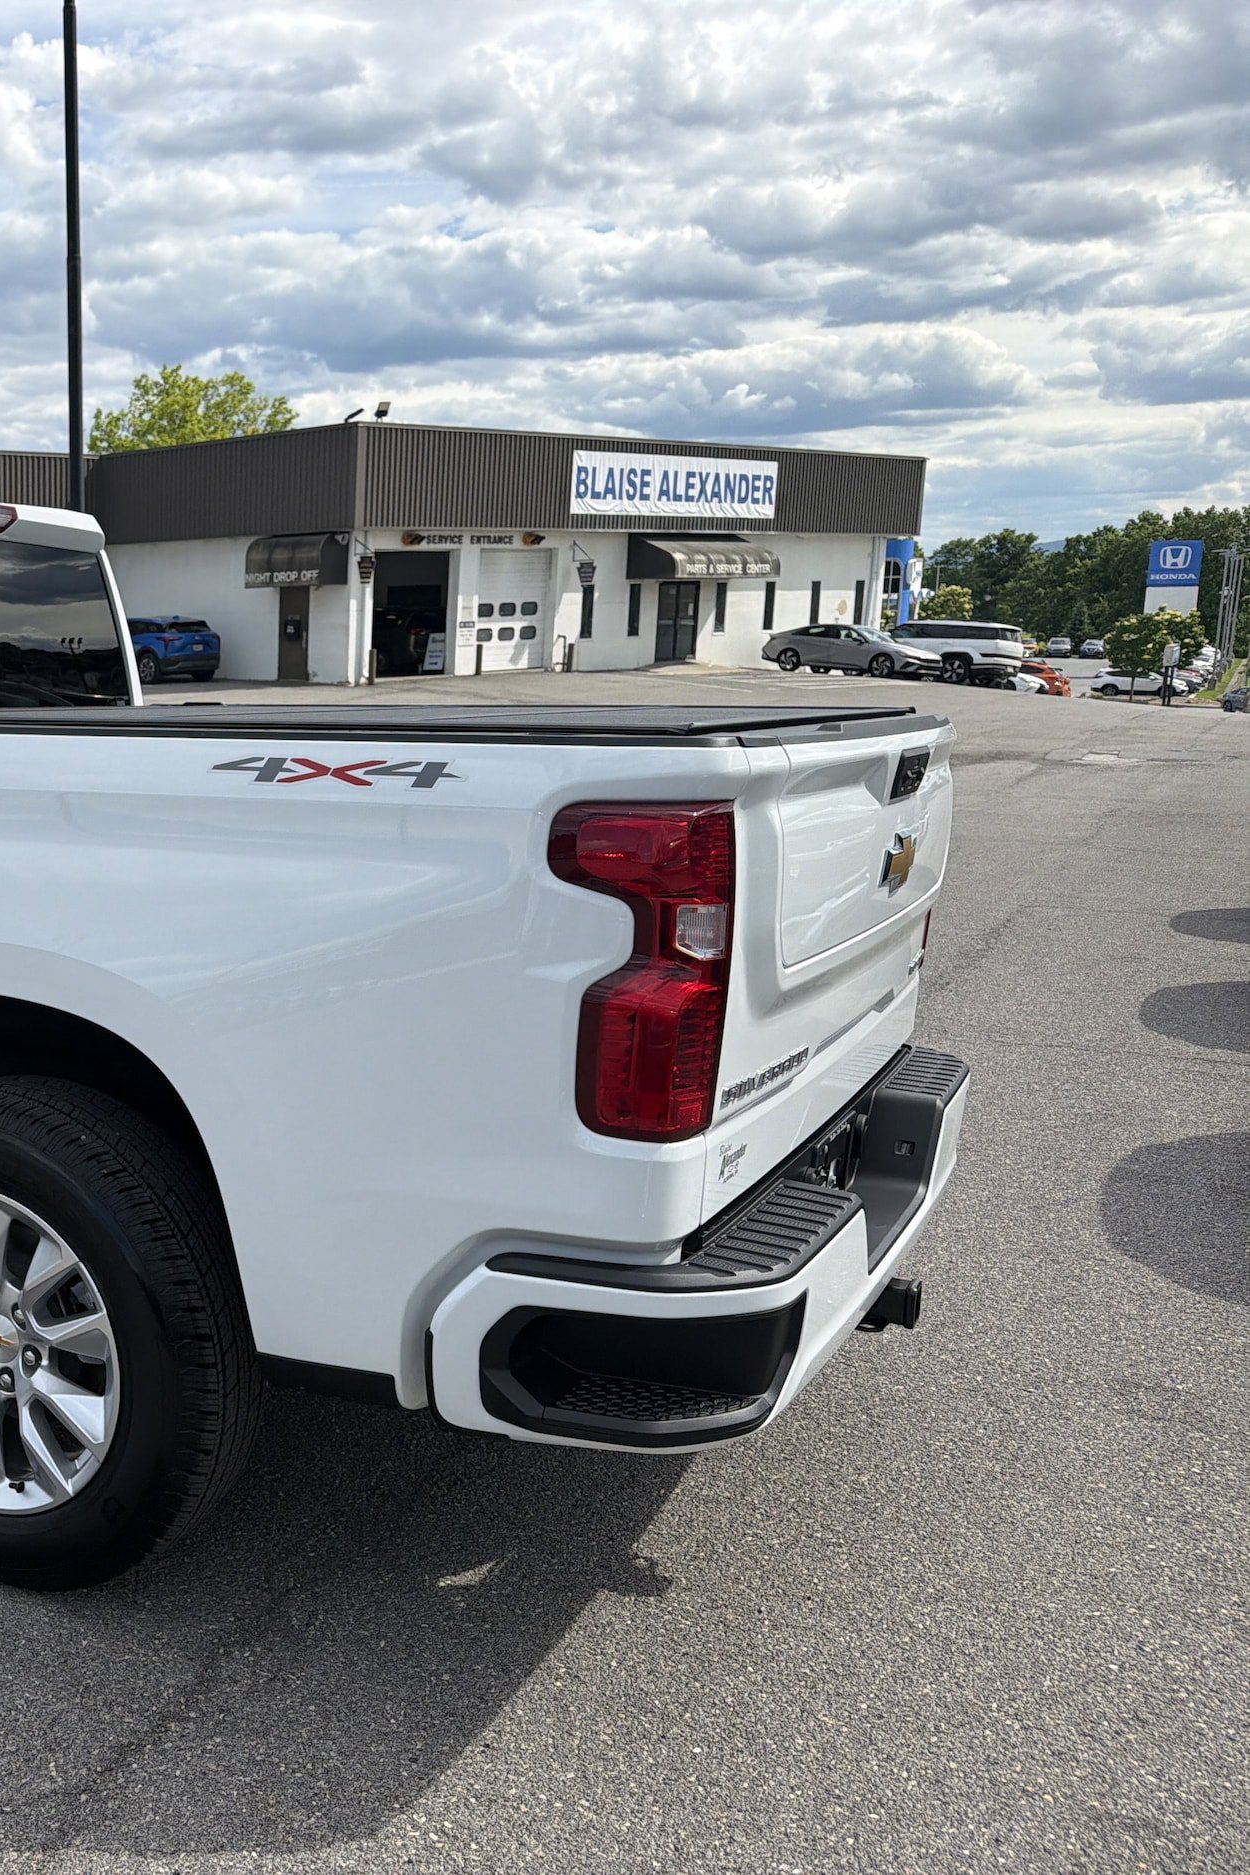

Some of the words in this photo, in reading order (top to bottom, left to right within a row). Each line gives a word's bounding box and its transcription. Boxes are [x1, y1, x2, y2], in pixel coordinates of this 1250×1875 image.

[575, 465, 652, 501] BLAISE
[657, 470, 775, 505] ALEXANDER
[426, 534, 464, 545] SERVICE
[470, 534, 514, 545] ENTRANCE
[686, 563, 707, 574] PARTS
[709, 564, 715, 574] &
[716, 563, 743, 574] SERVICE
[746, 563, 771, 574] CENTER
[245, 572, 271, 584] NIGHT
[273, 570, 298, 583] DROP
[300, 569, 319, 581] OFF
